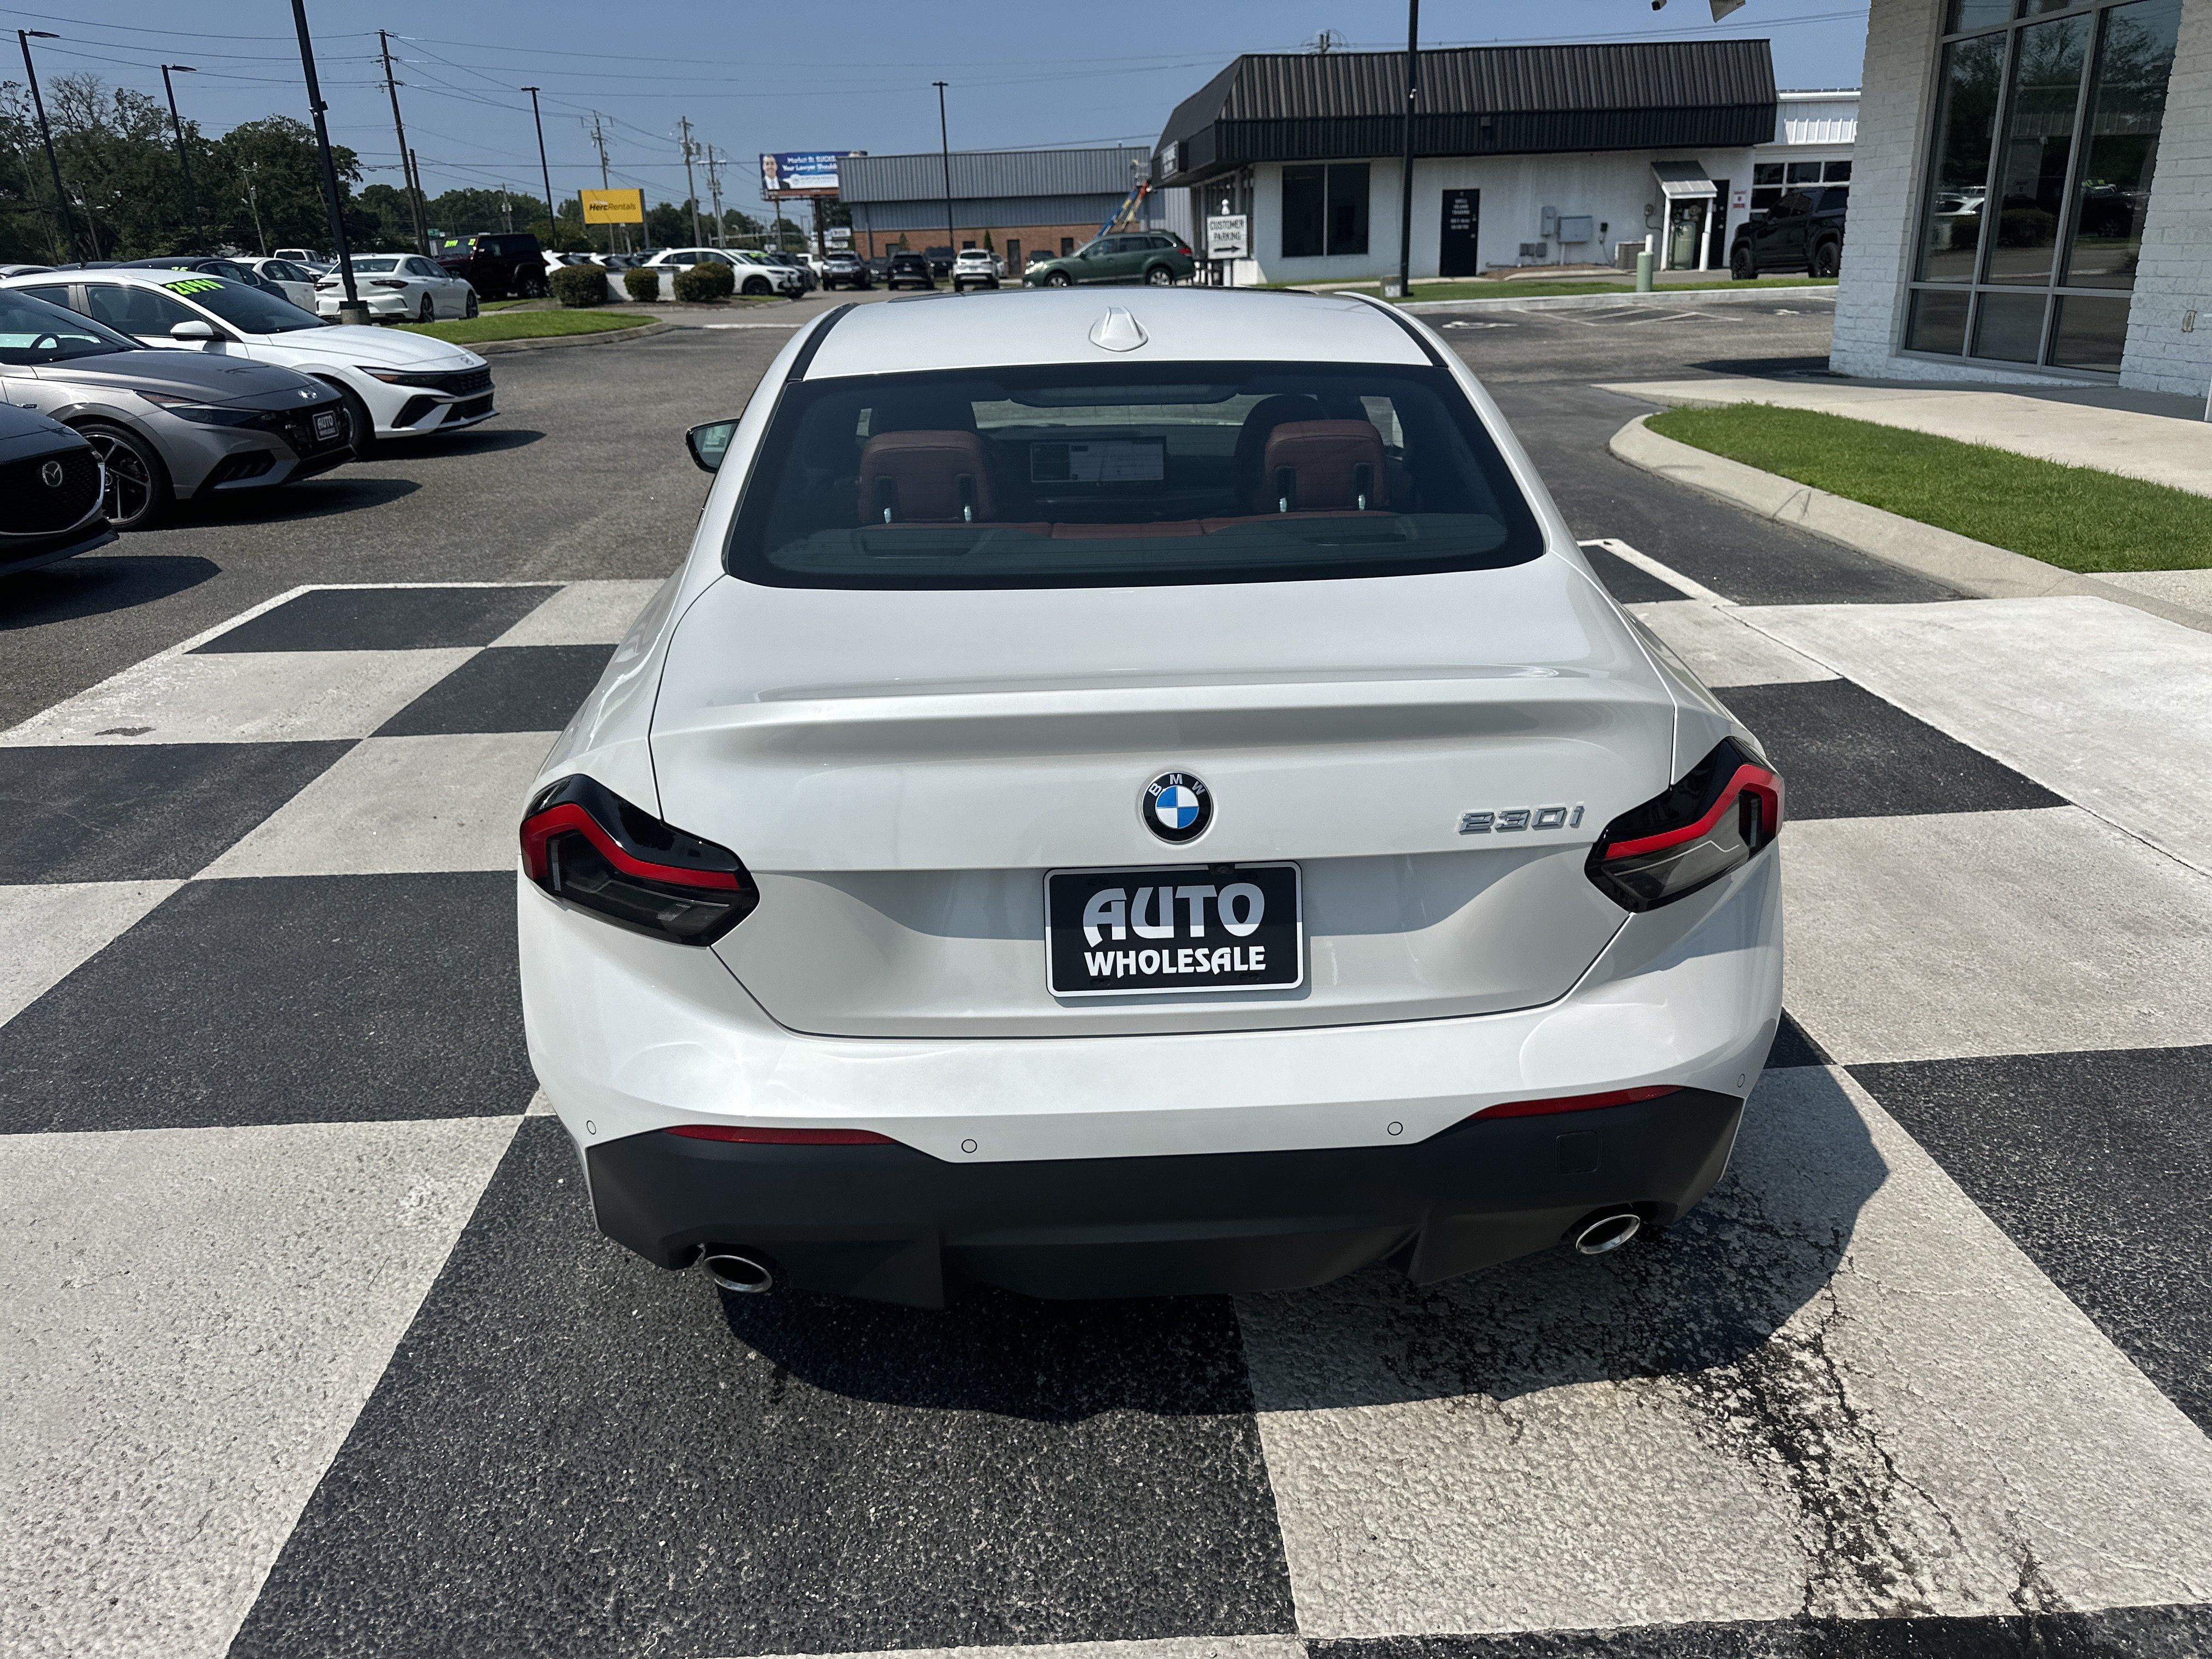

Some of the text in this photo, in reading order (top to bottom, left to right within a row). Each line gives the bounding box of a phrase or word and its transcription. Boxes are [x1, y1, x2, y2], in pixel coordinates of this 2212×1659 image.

[1210, 220, 1244, 230] CUSTOMER
[1214, 232, 1241, 241] PARKING
[166, 279, 225, 295] 20990
[318, 415, 332, 429] AUTO
[1148, 774, 1206, 796] BMW
[1458, 804, 1584, 836] 230i
[1083, 882, 1265, 948] AUTO
[1084, 946, 1266, 979] WHOLESALE
